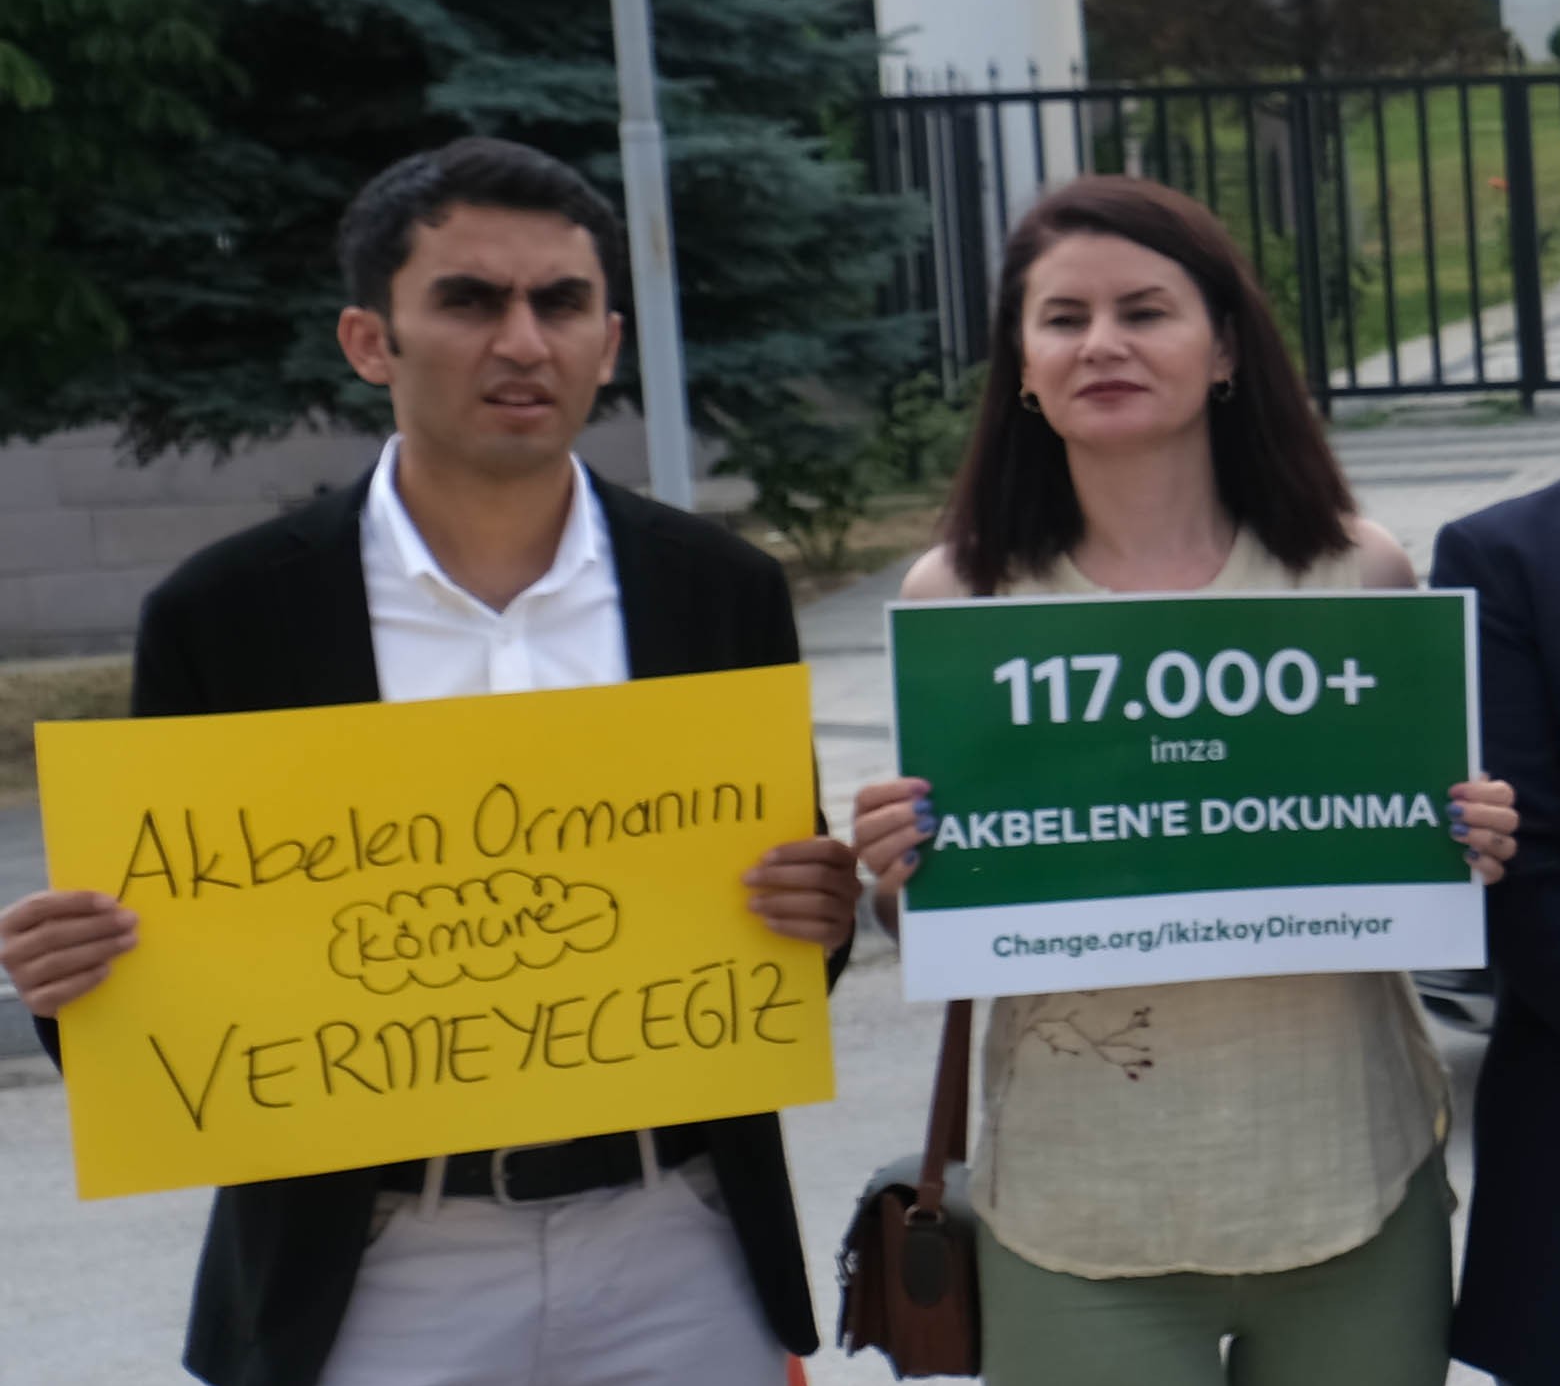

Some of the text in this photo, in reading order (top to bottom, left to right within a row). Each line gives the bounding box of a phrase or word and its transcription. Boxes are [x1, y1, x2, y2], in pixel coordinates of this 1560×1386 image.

[993, 648, 1377, 726] 117.000+
[1151, 734, 1227, 764] imza
[117, 781, 765, 903] Akbelen Ormanını
[932, 793, 1439, 851] AKBELEN'E DOKUNMA
[992, 912, 1393, 959] Change.org/ikizkoyDireniyor
